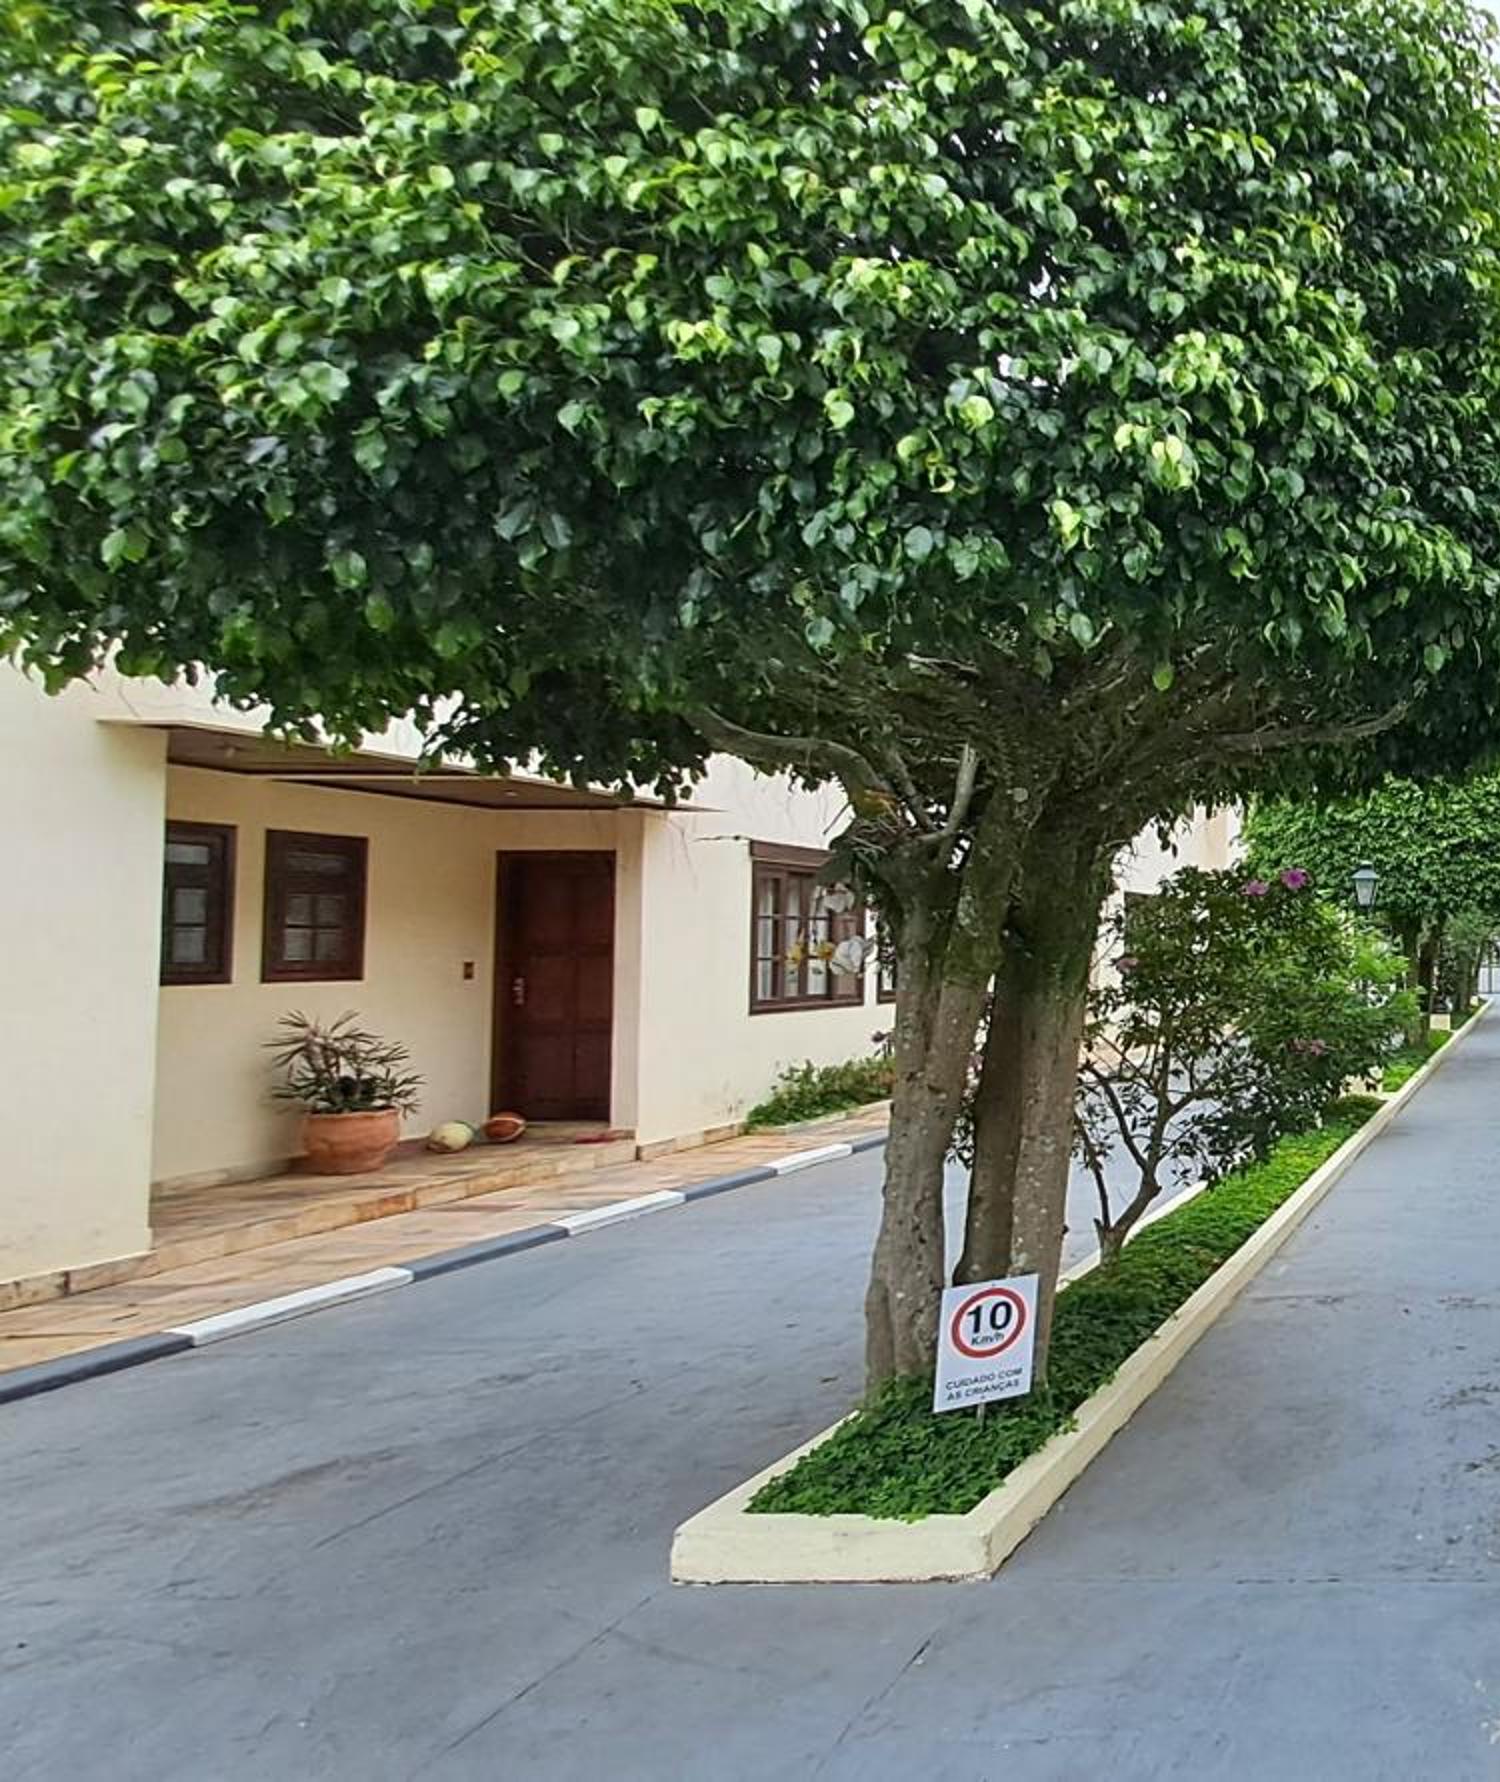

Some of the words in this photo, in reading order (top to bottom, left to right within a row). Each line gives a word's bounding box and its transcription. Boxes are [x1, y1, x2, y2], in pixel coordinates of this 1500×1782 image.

[968, 1301, 1012, 1334] 10
[945, 1374, 995, 1391] CUIDADO
[998, 1368, 1023, 1380] COM
[947, 1391, 961, 1400] AS
[965, 1379, 1019, 1397] CRIANÇAS
